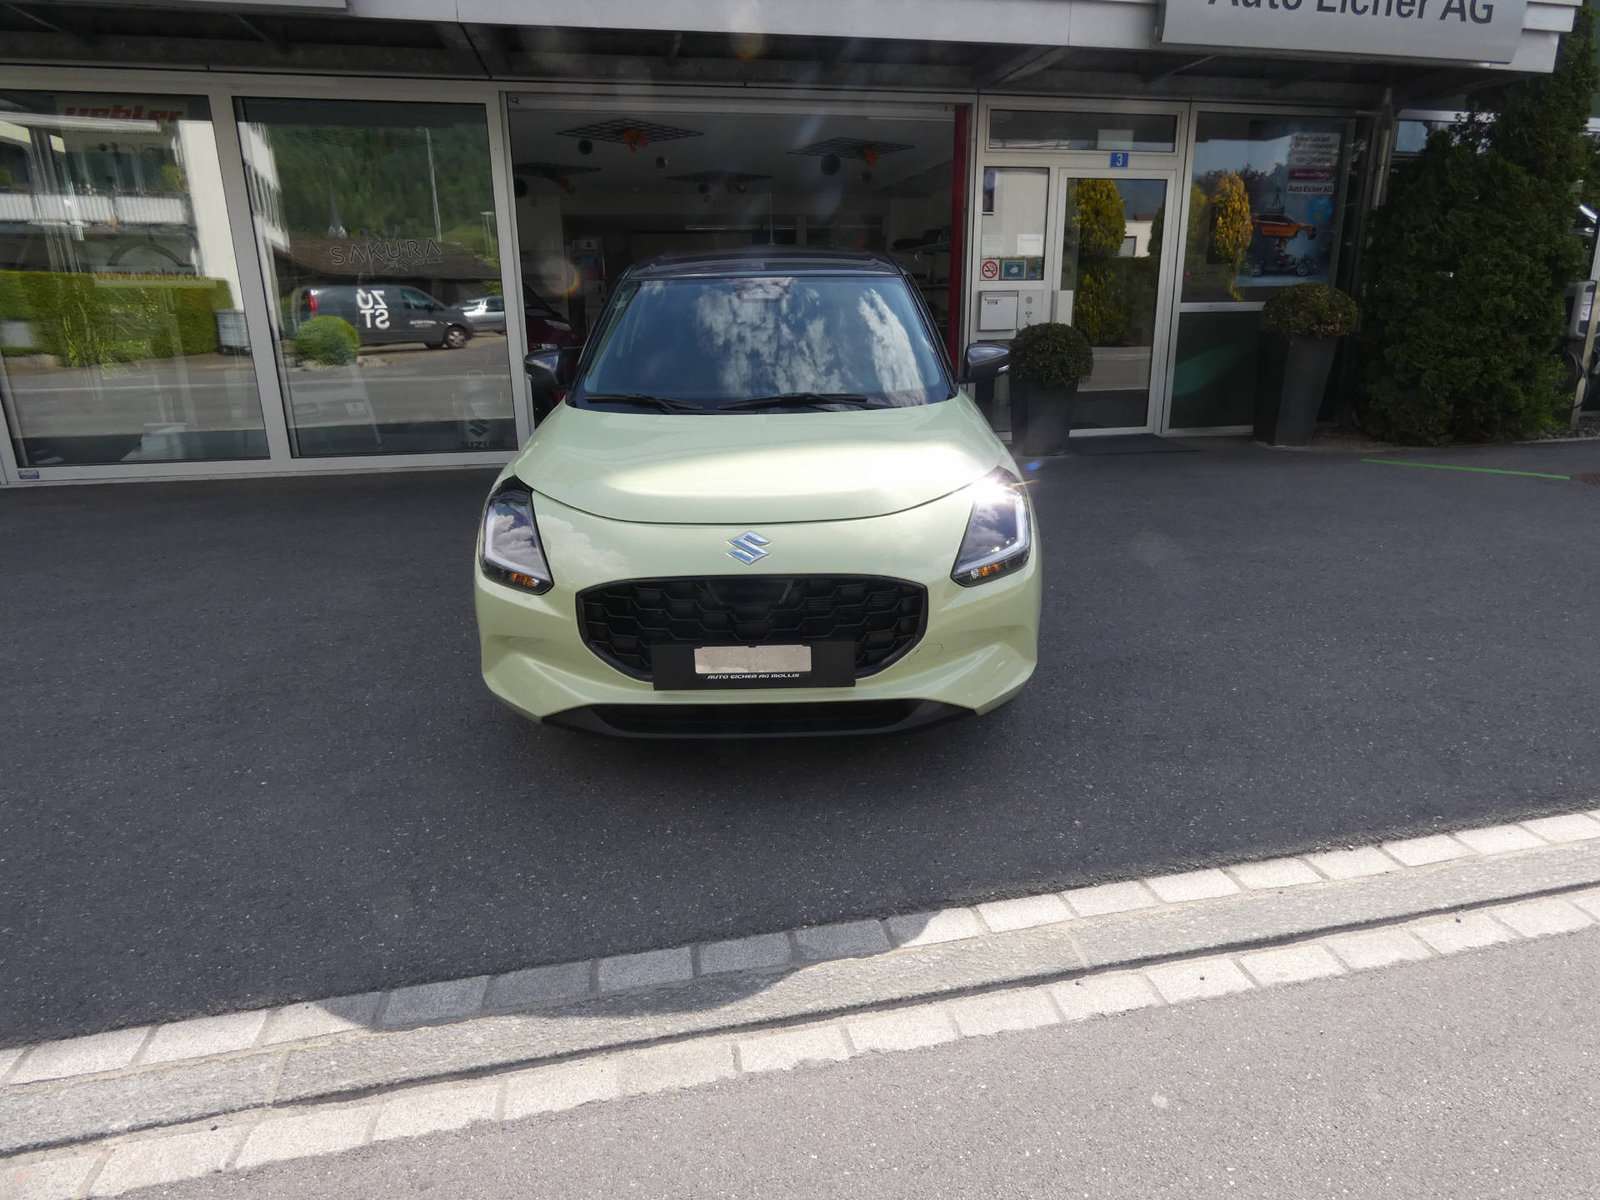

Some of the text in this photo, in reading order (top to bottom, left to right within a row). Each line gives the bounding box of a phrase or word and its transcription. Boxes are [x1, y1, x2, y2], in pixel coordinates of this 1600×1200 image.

[1439, 0, 1494, 24] AG
[1116, 153, 1123, 166] 3
[330, 239, 441, 264] SAKURA
